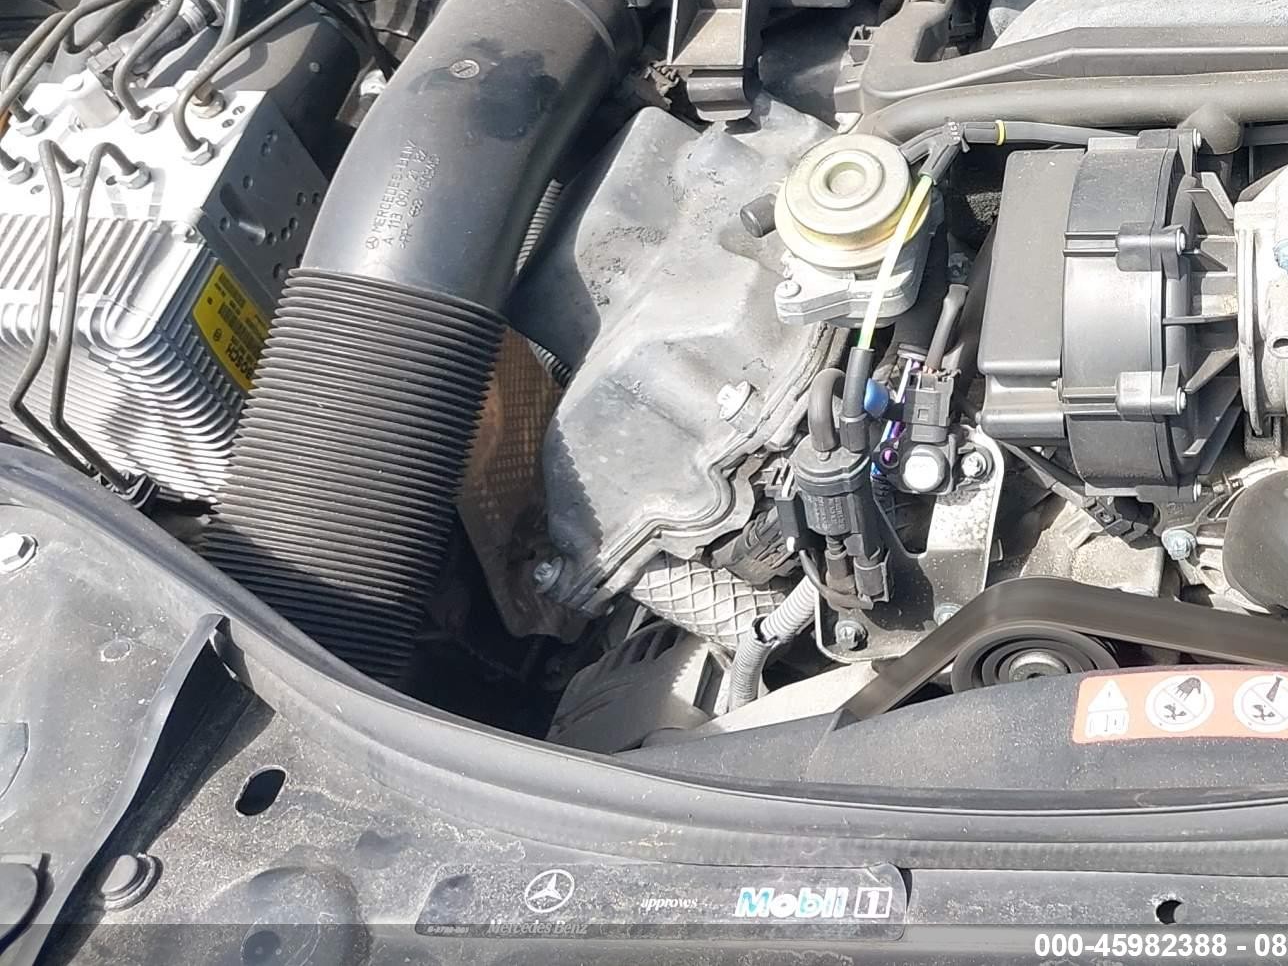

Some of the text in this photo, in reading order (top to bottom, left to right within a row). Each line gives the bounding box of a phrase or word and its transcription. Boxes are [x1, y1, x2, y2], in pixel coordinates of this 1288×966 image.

[388, 213, 403, 229] 113
[383, 236, 395, 246] A
[733, 887, 849, 918] Mobil
[487, 919, 552, 935] Mercedes
[553, 920, 588, 935] Benz
